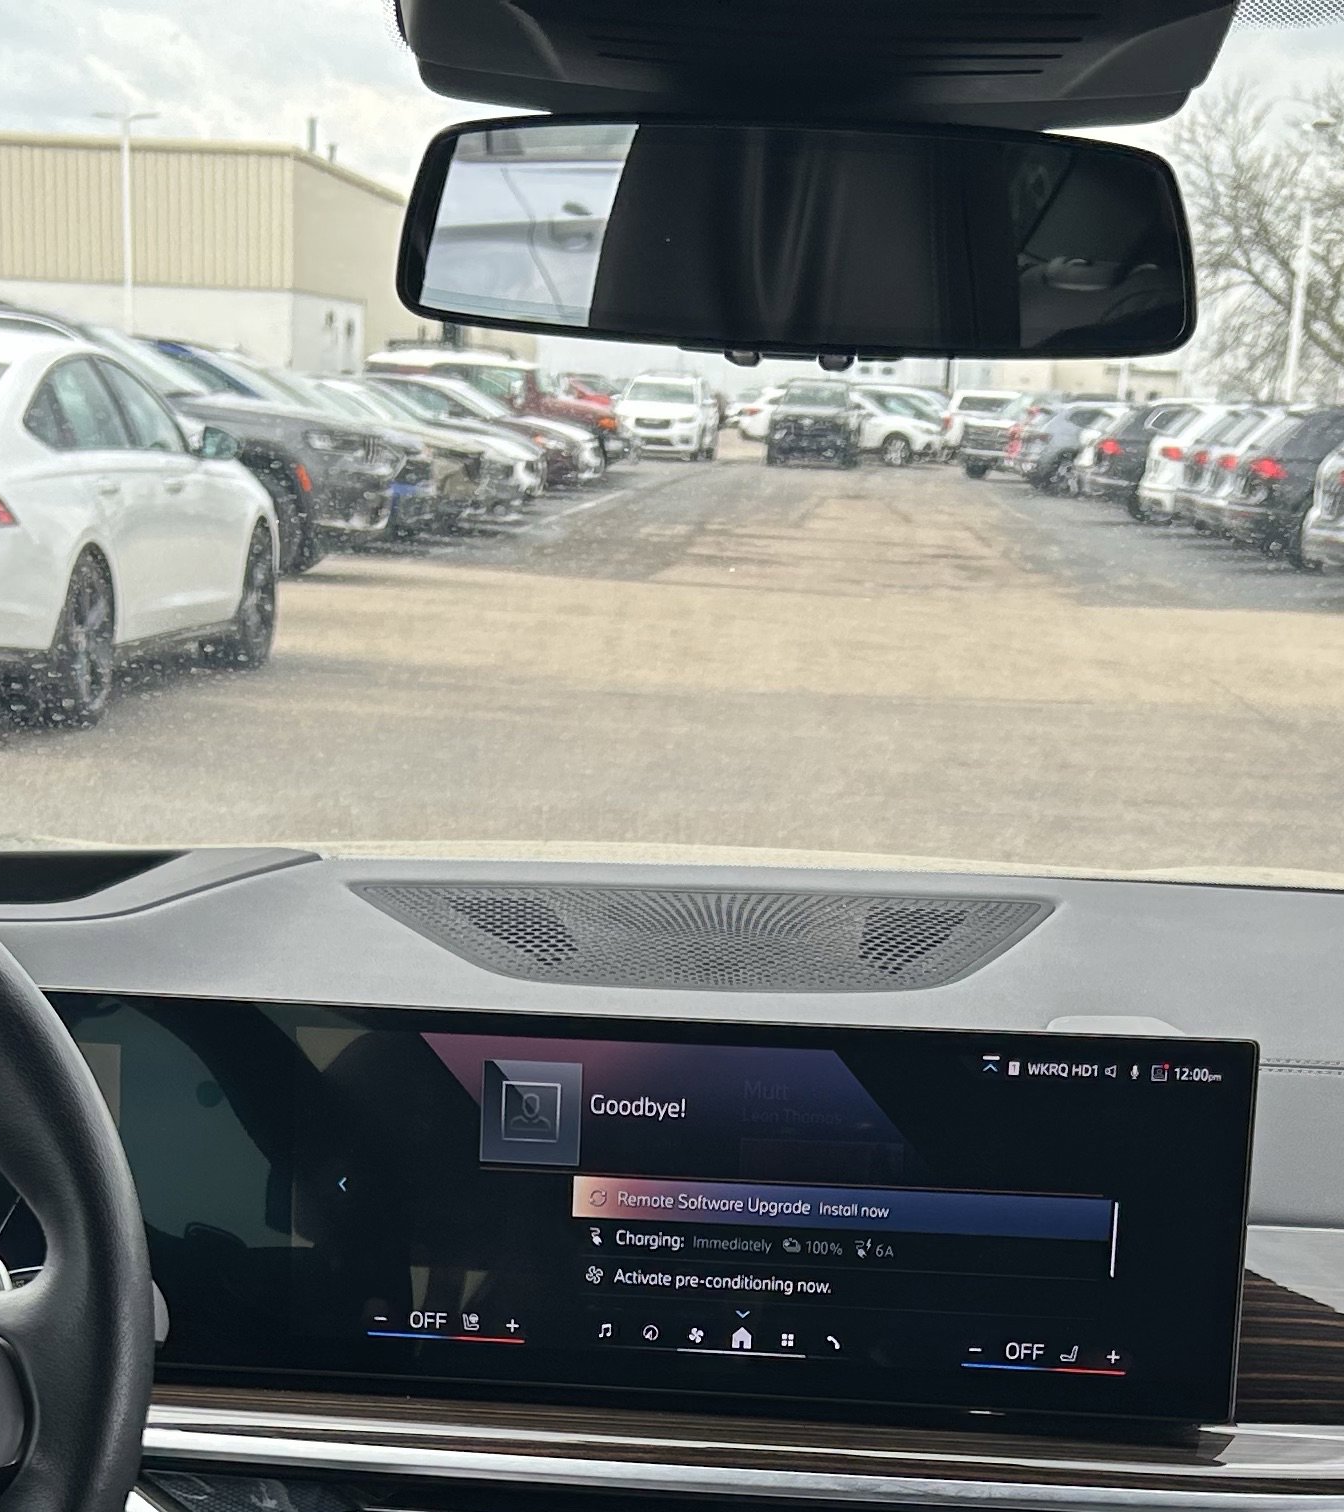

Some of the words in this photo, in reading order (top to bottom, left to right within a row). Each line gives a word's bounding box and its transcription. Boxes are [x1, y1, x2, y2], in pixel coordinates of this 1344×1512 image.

[1027, 1062, 1069, 1077] WKRQ
[1071, 1064, 1099, 1077] HD1
[589, 1094, 687, 1121] Goodbye!
[617, 1190, 674, 1209] Remote
[677, 1193, 744, 1213] Software
[747, 1198, 811, 1216] Upgrade
[819, 1200, 858, 1216] Install
[861, 1206, 890, 1218] now
[615, 1229, 685, 1251] Charging:
[692, 1235, 773, 1254] Immediately
[805, 1240, 843, 1255] 100%
[875, 1244, 894, 1257] 6A
[613, 1268, 671, 1286] Activate
[675, 1272, 794, 1296] pre-conditioning
[797, 1280, 832, 1294] now.
[409, 1311, 448, 1329] OFF
[1006, 1342, 1045, 1360] OFF
